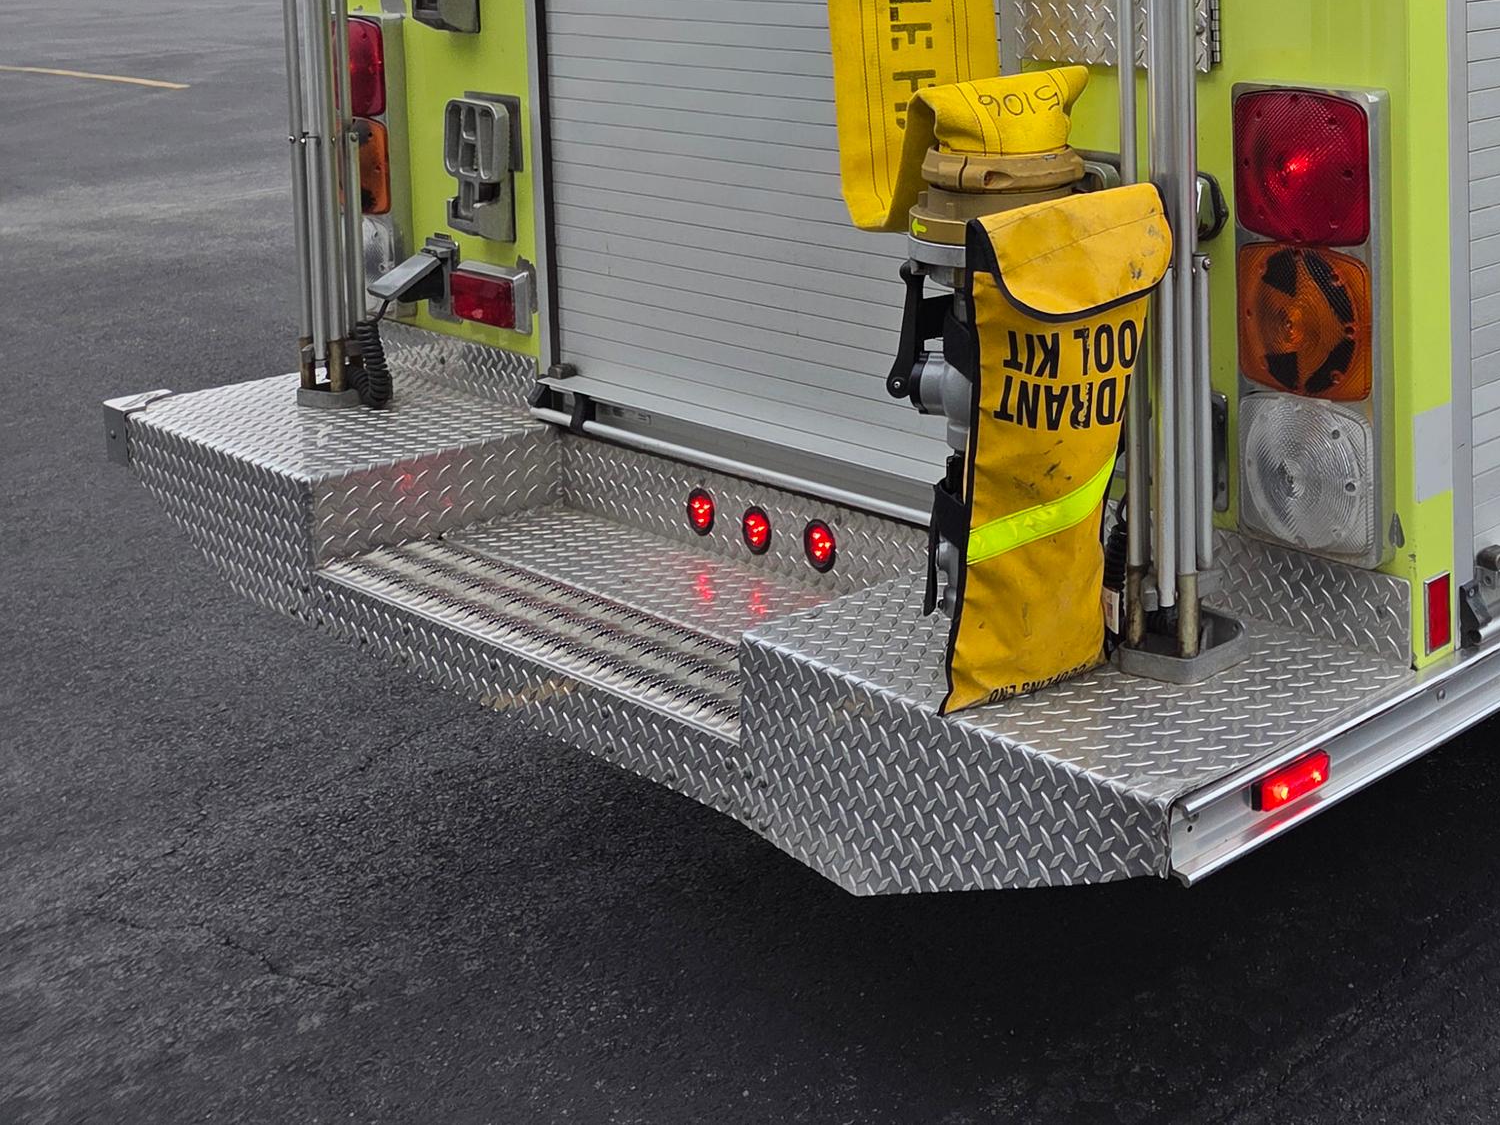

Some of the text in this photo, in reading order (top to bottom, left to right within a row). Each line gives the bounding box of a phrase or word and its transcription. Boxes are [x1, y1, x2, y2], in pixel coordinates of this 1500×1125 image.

[978, 84, 1061, 117] 5106
[1003, 318, 1139, 379] OOL KIT
[988, 684, 1018, 703] END
